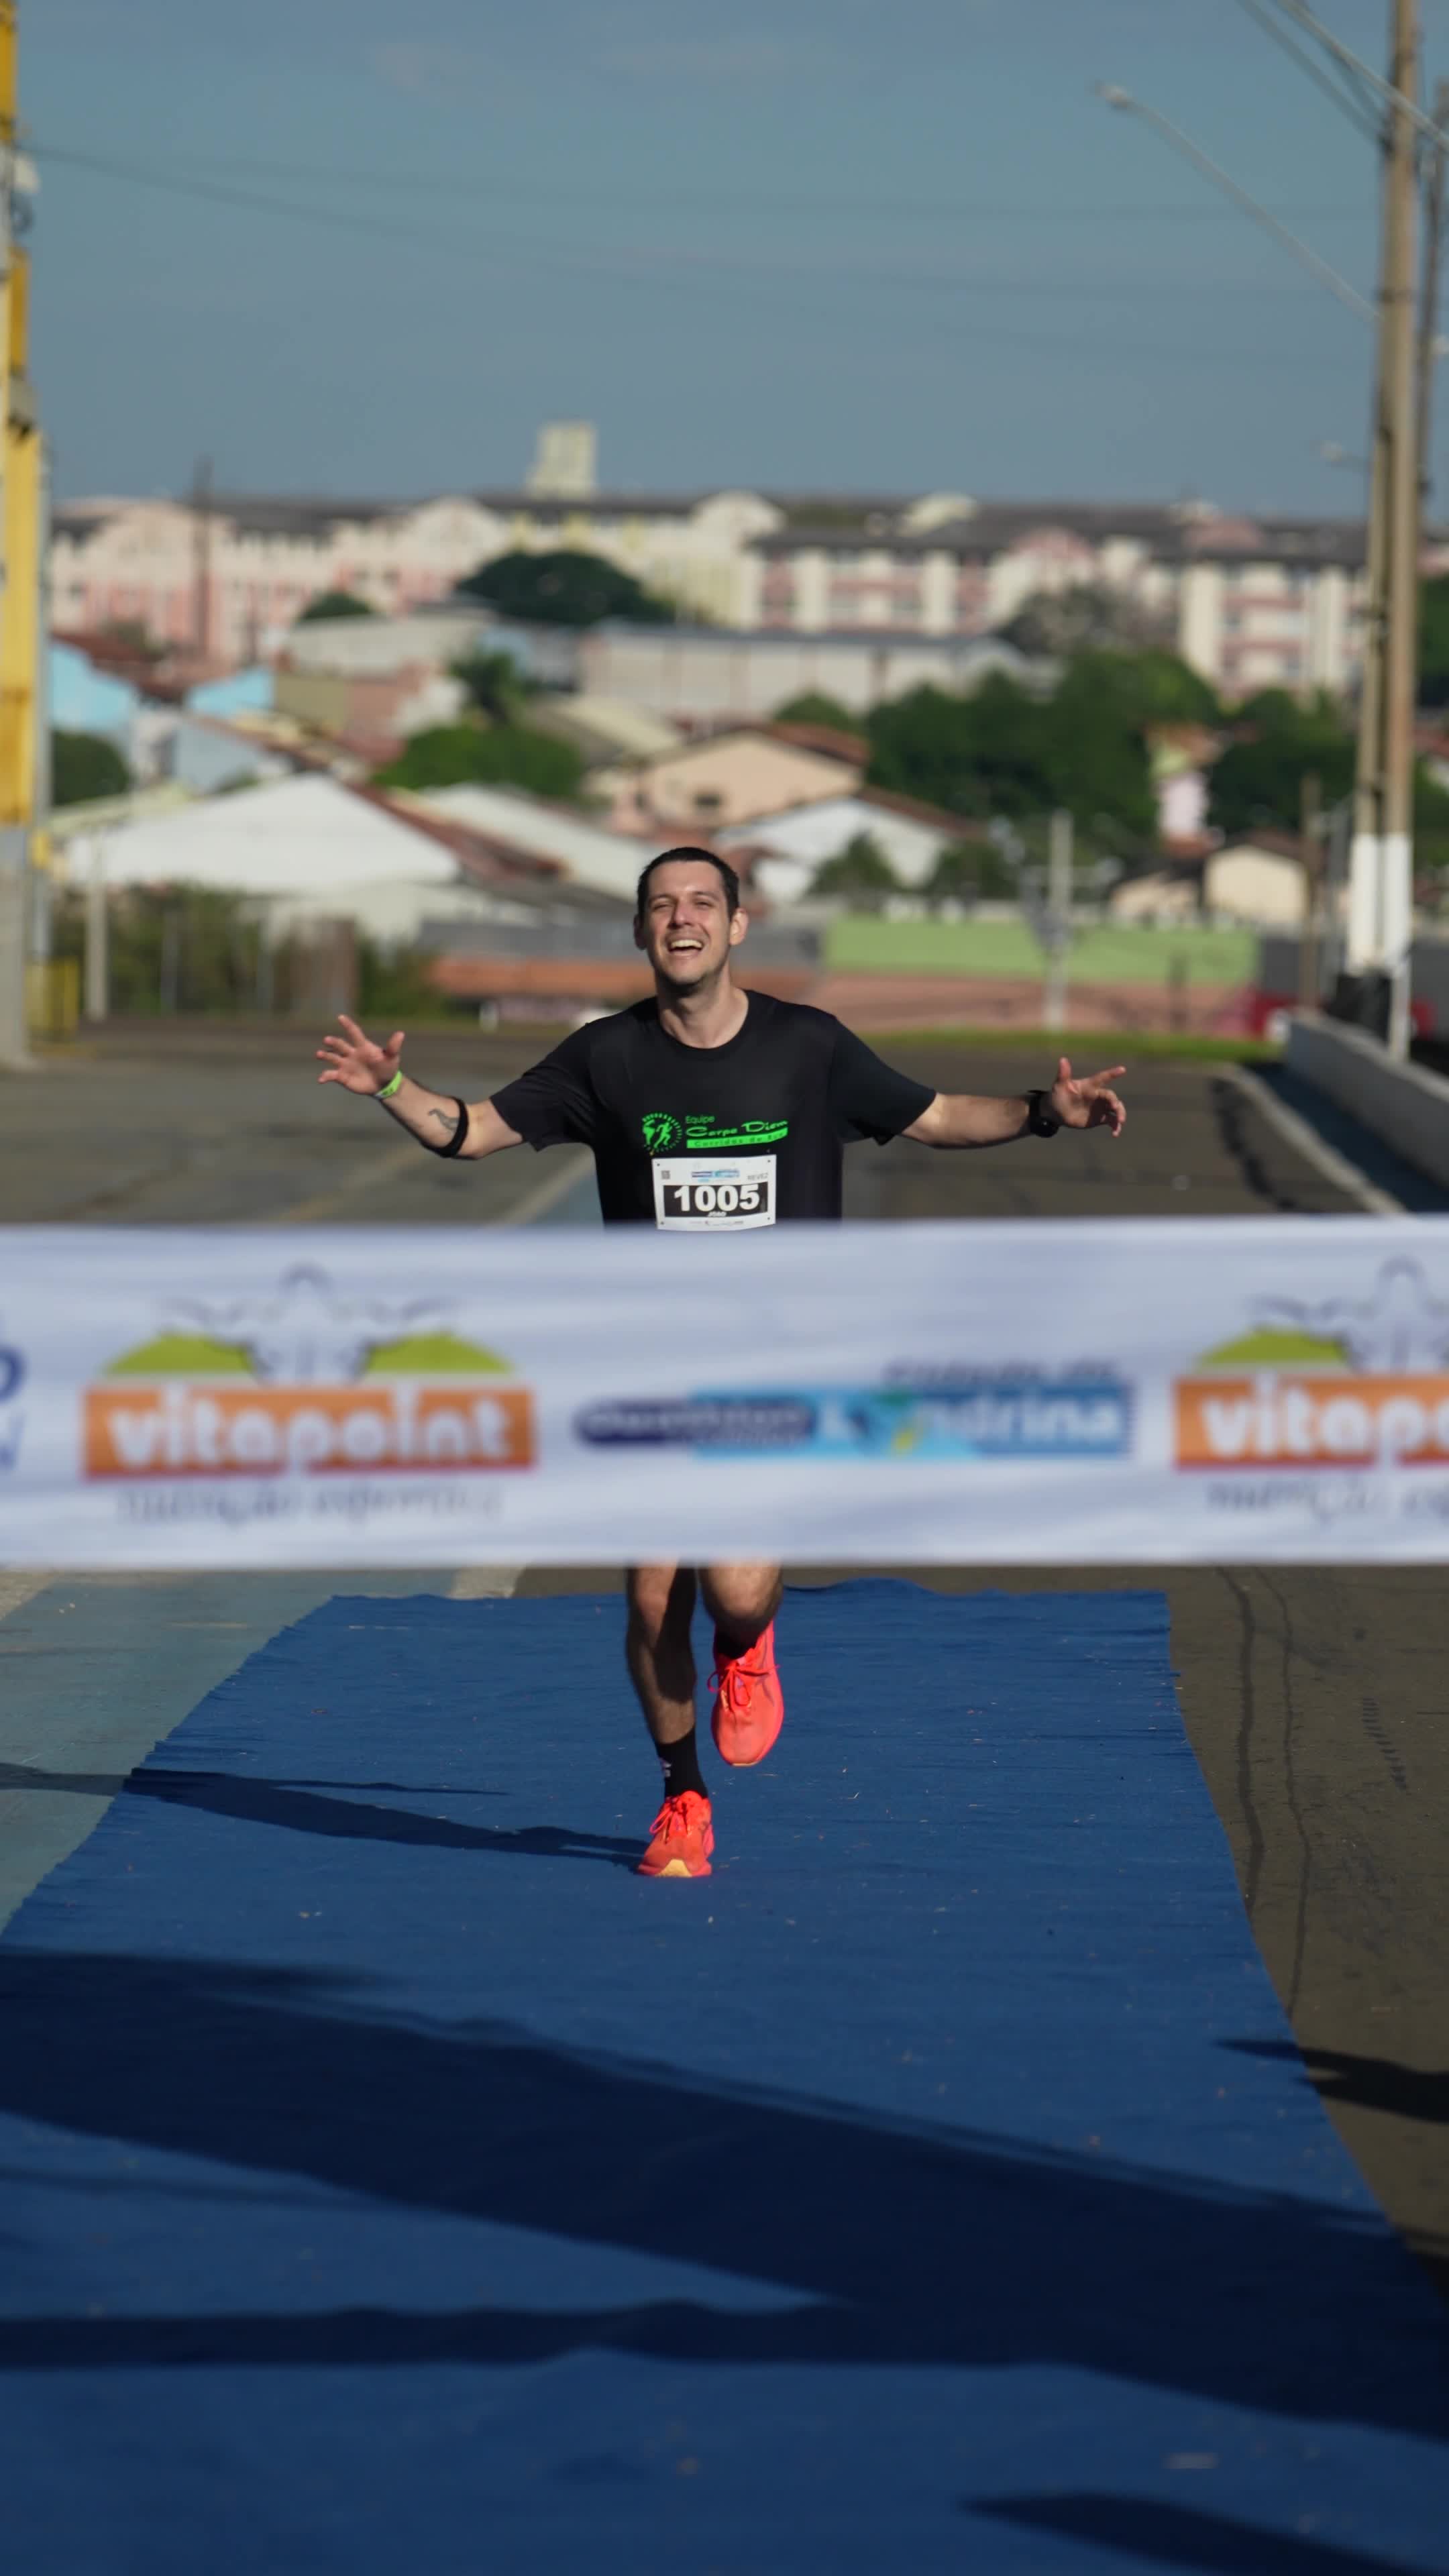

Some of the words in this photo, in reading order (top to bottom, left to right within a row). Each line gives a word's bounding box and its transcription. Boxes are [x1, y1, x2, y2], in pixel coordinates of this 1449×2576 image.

[686, 1115, 715, 1124] Equipe
[686, 1126, 738, 1137] Carpe
[741, 1120, 788, 1132] Diem
[674, 1184, 760, 1212] 1005
[107, 1382, 513, 1479] vitapoint
